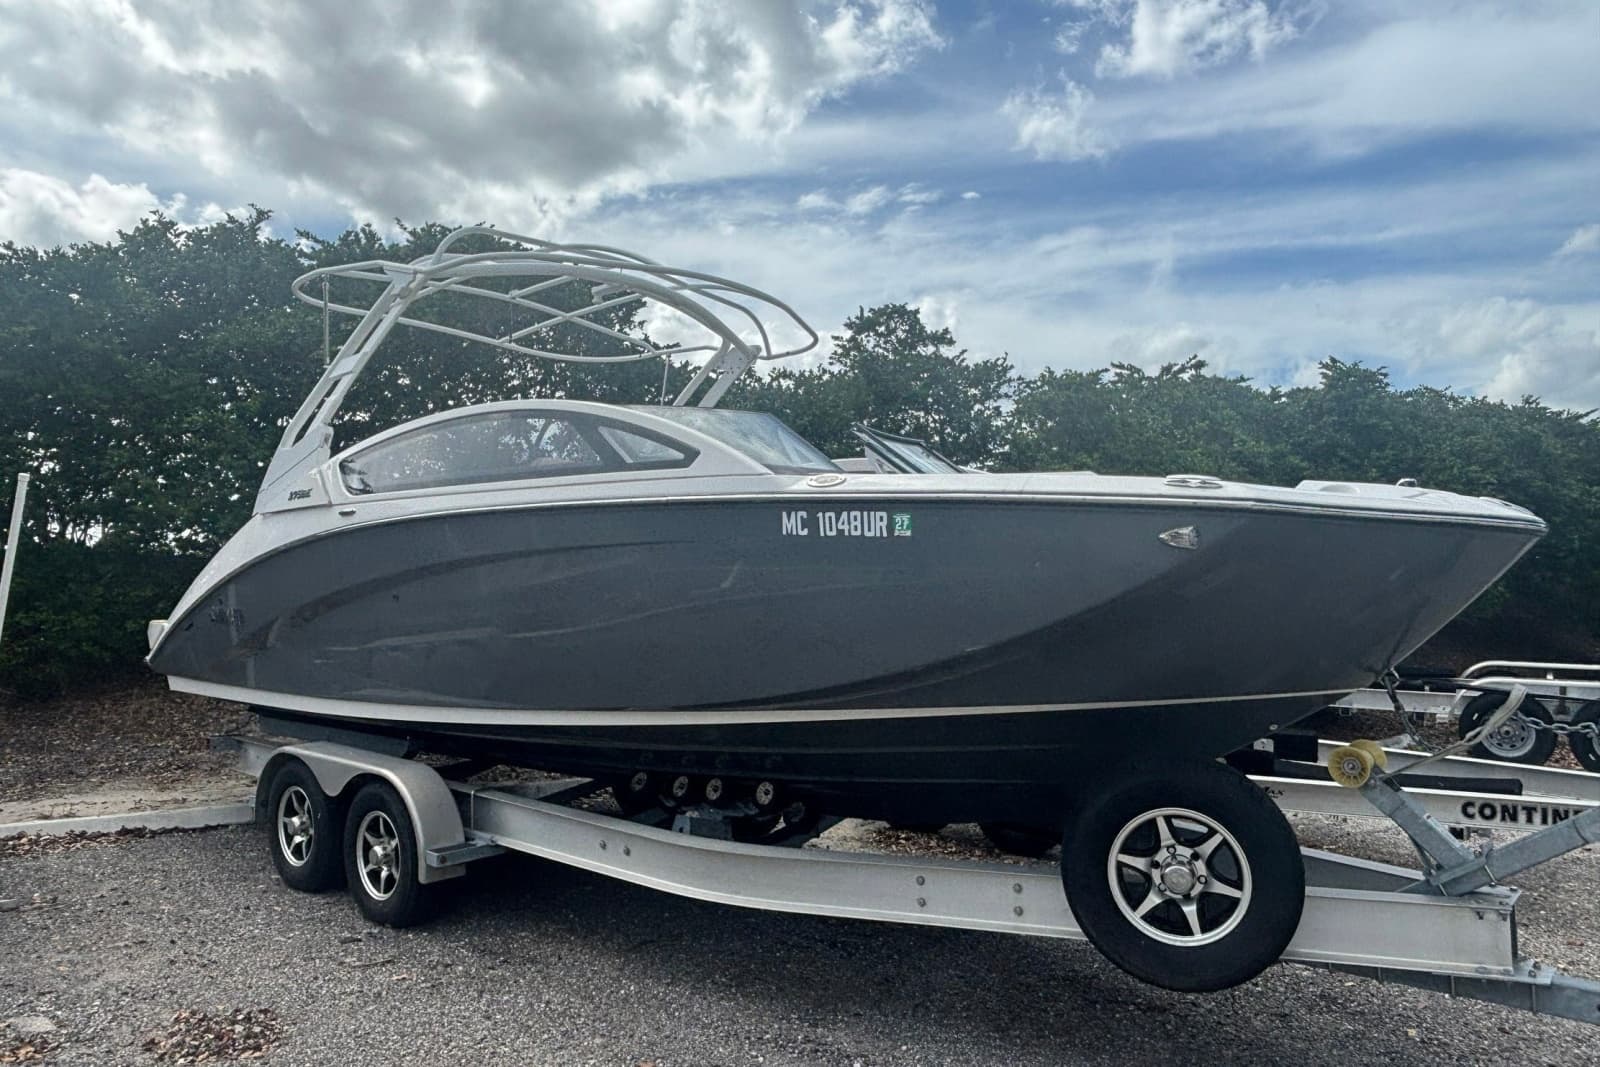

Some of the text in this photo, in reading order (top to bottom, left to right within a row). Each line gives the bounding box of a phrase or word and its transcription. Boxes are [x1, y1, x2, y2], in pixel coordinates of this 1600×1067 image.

[782, 511, 888, 537] MC 1048UR
[895, 517, 909, 530] 27
[1461, 801, 1583, 825] CONTIN
